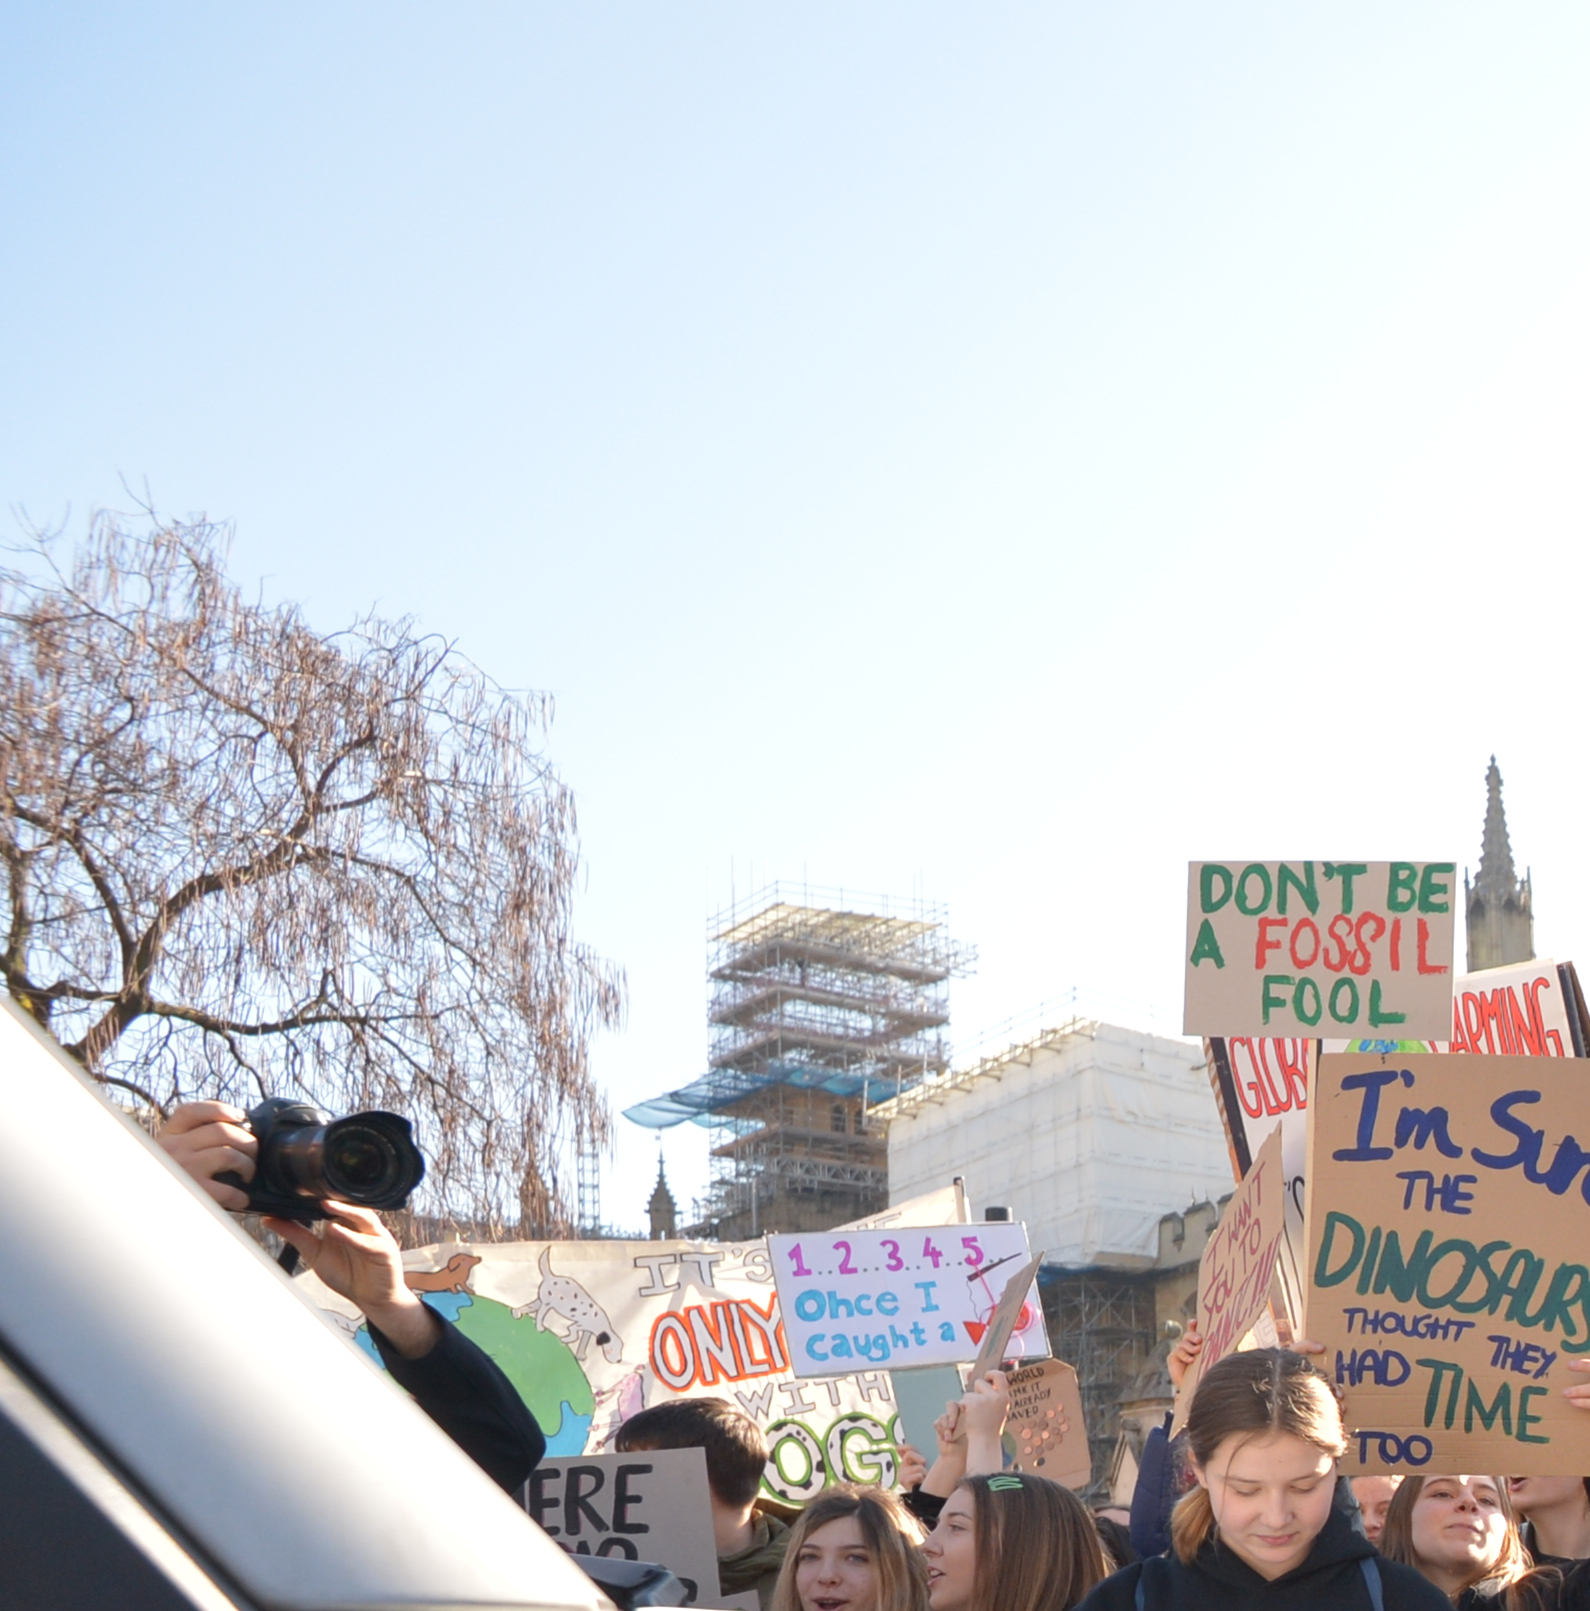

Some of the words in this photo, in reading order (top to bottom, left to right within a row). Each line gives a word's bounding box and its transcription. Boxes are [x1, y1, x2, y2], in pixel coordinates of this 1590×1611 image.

[1199, 861, 1367, 918] DON'T
[1386, 861, 1454, 915] BE
[1189, 918, 1226, 970] A
[1254, 911, 1449, 976] FOSSIL
[1261, 974, 1407, 1028] FOOL
[1428, 976, 1565, 1058] ARMING
[1332, 1068, 1464, 1162] I'm
[1227, 1160, 1267, 1244] WANT
[1396, 1170, 1479, 1215] THE
[633, 1247, 775, 1298] IT'S
[1239, 1217, 1262, 1276] TO
[914, 1280, 940, 1314] I
[649, 1292, 791, 1393] ONLY
[805, 1321, 928, 1363] caught
[938, 1321, 956, 1343] a
[1342, 1307, 1476, 1342] THOUGHT
[1486, 1334, 1560, 1380] THEY
[735, 1372, 891, 1420] WITH
[1334, 1346, 1411, 1388] HAD
[1415, 1357, 1552, 1445] TIME
[1356, 1430, 1432, 1465] TOO
